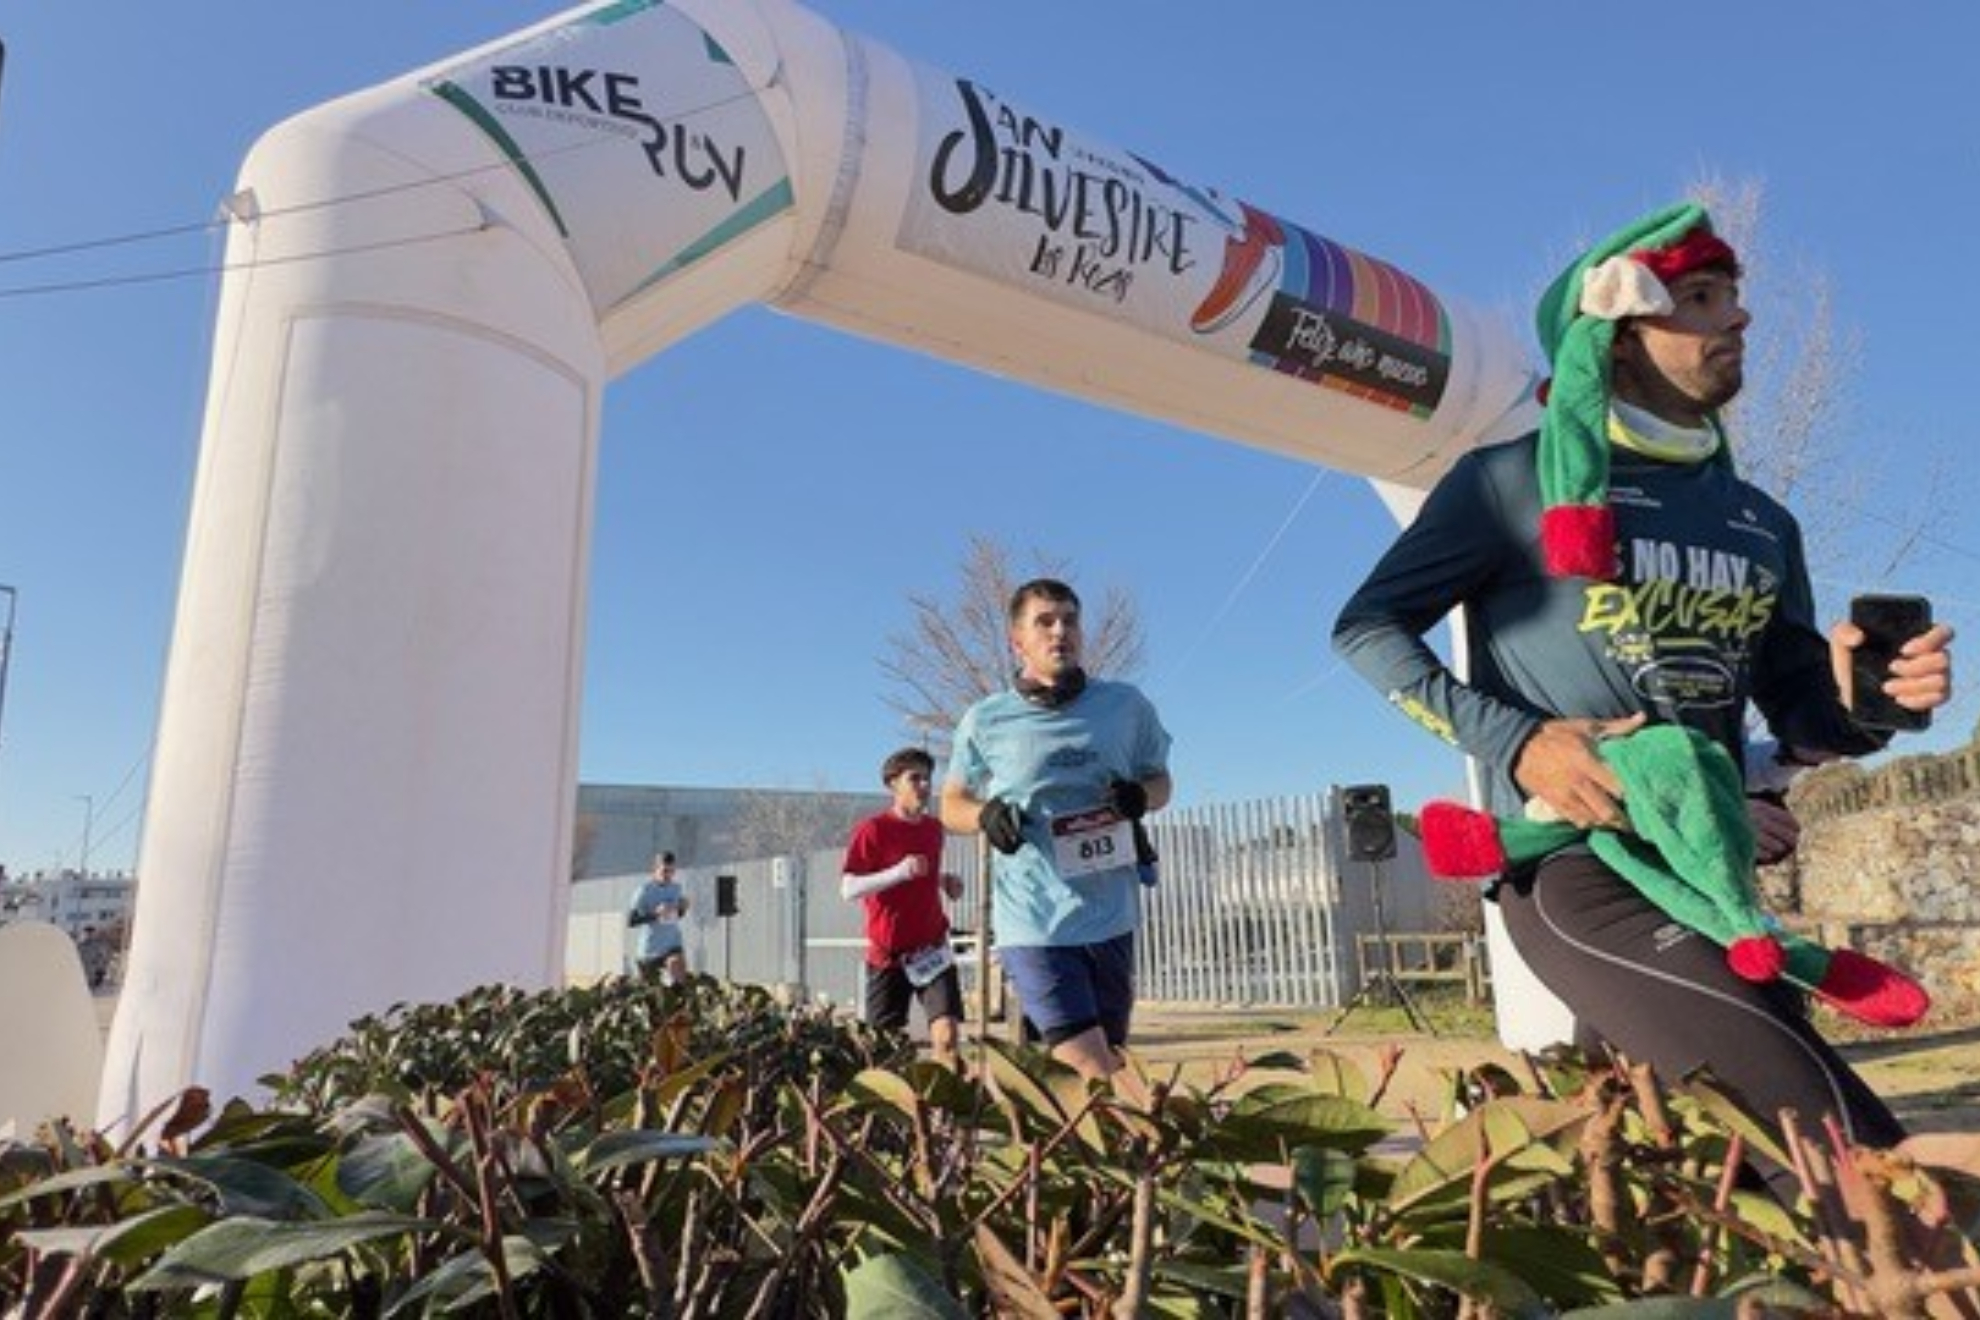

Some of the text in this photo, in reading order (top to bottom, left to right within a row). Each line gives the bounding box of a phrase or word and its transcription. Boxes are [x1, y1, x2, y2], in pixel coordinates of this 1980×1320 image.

[491, 66, 642, 120] BIKE
[1631, 537, 1749, 596] NO HAY
[1577, 578, 1777, 638] EXCUSAS
